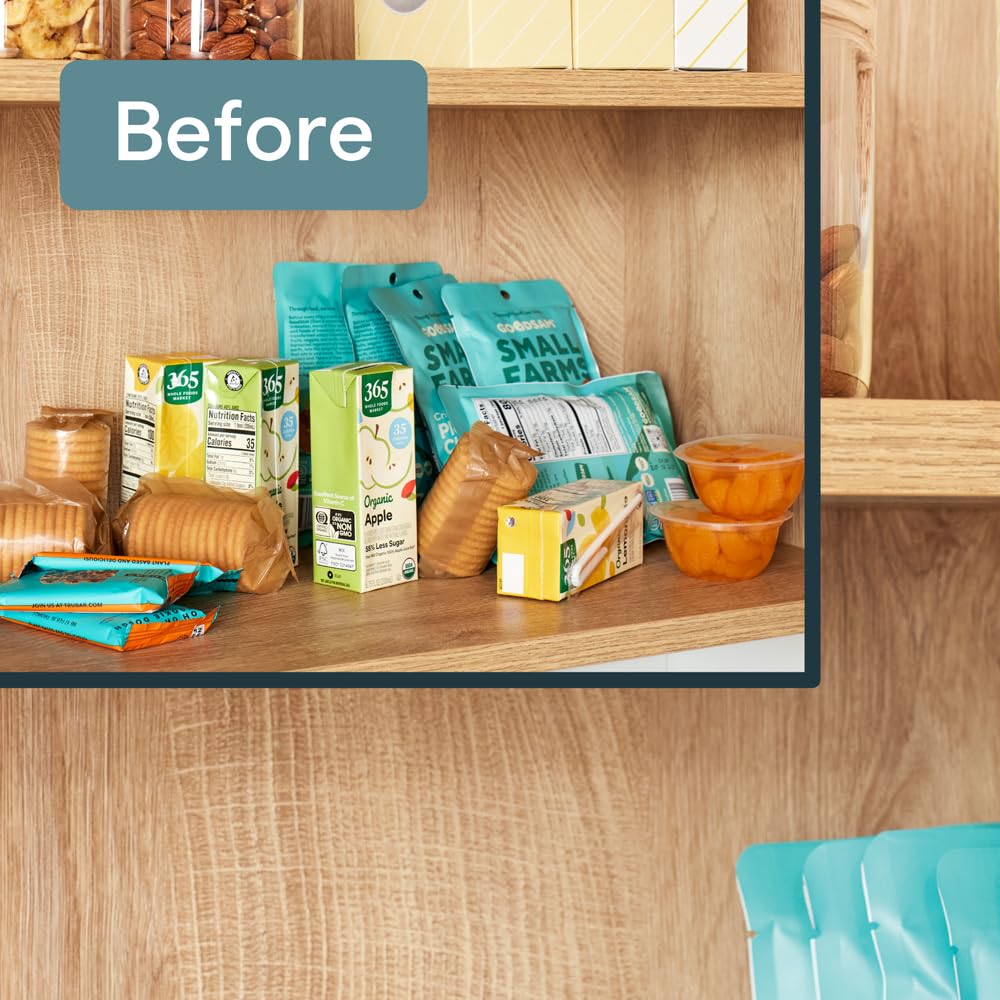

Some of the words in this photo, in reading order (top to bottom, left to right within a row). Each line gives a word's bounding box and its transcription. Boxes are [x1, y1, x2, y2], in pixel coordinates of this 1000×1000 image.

[424, 339, 467, 371] SMA
[496, 333, 582, 362] SMALL
[502, 357, 590, 384] FARMS
[166, 369, 200, 390] 365
[262, 372, 283, 397] 365
[431, 370, 476, 389] FAR
[364, 379, 388, 402] 365
[208, 410, 239, 420] Nutrition
[240, 412, 256, 422] Facts
[284, 416, 294, 427] 35
[394, 424, 406, 436] 35
[207, 437, 232, 447] Calories
[246, 438, 255, 449] 35
[364, 493, 393, 510] Organic
[336, 522, 352, 531] NON
[364, 509, 393, 527] Apple
[376, 541, 388, 550] Less
[389, 539, 405, 548] Sugar
[183, 611, 198, 619] OH
